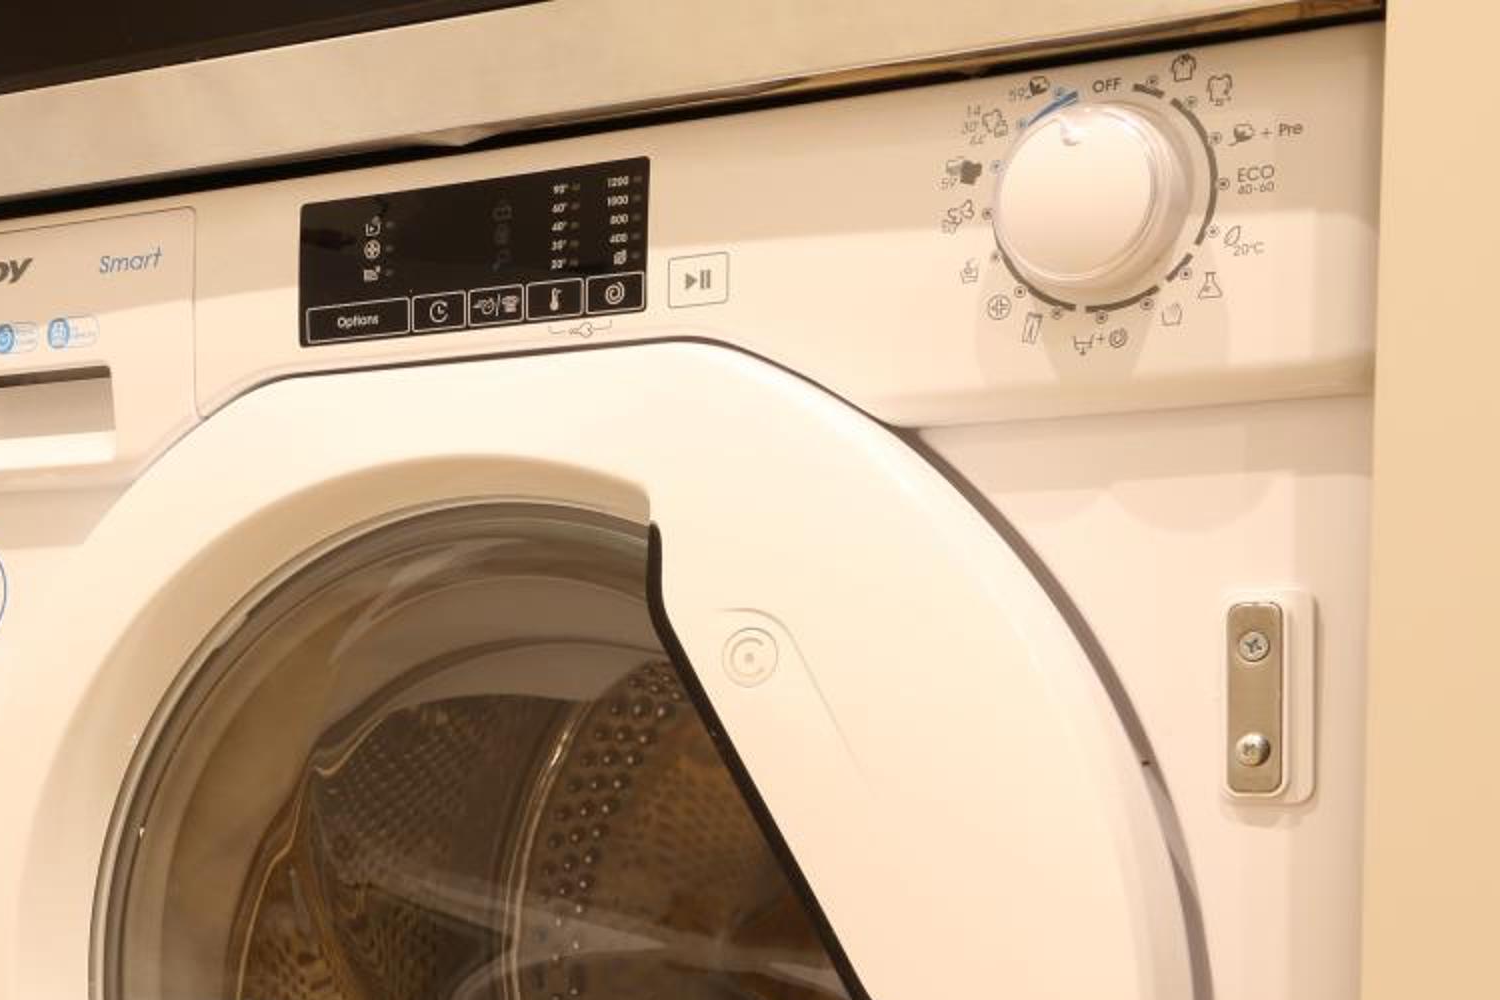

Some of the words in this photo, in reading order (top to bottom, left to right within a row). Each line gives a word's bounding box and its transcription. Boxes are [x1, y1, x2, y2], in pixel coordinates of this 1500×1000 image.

[1092, 77, 1122, 93] OFF
[1278, 122, 1303, 137] Pre
[1237, 165, 1275, 183] ECO
[1237, 182, 1275, 195] 40-60
[610, 214, 629, 225] 800
[99, 247, 163, 275] Smart
[337, 314, 379, 330] Options
